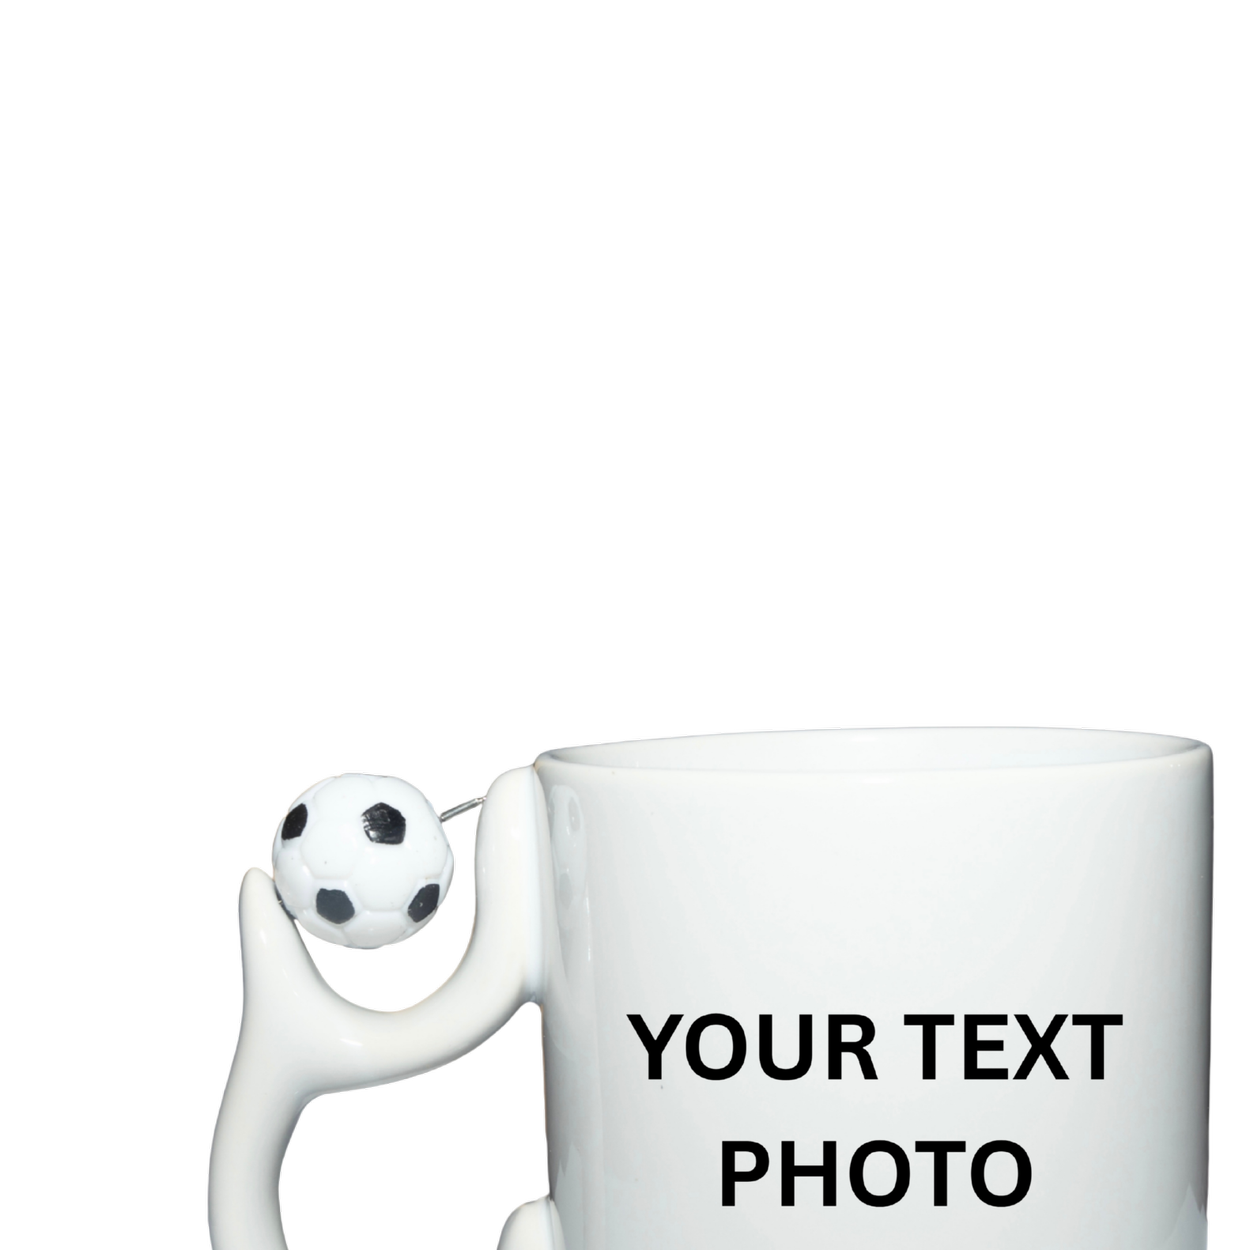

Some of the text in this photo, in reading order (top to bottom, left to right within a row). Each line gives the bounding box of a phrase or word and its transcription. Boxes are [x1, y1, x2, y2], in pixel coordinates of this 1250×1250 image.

[626, 1012, 1124, 1081] YOUR TEXT
[721, 1139, 1032, 1208] PHOTO
